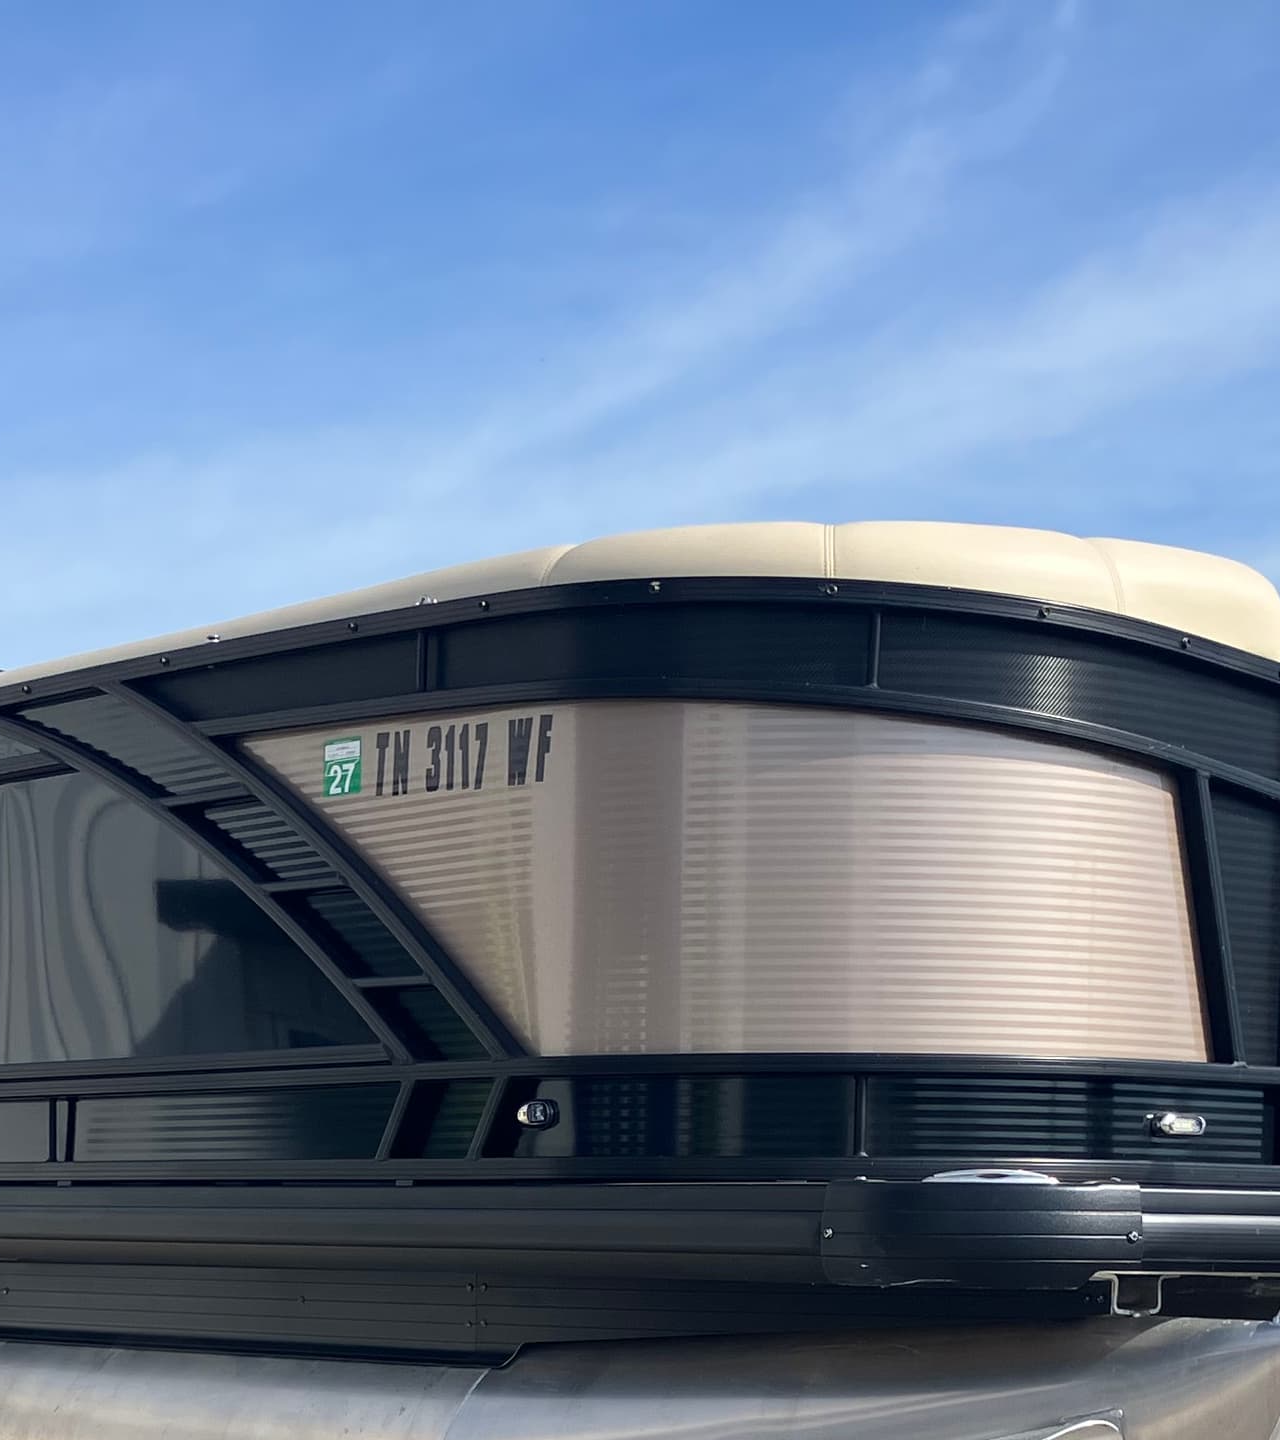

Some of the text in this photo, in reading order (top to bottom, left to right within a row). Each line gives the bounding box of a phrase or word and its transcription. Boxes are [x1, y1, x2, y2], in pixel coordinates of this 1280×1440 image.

[329, 763, 356, 795] 27
[376, 714, 553, 796] TN 3117 WF
